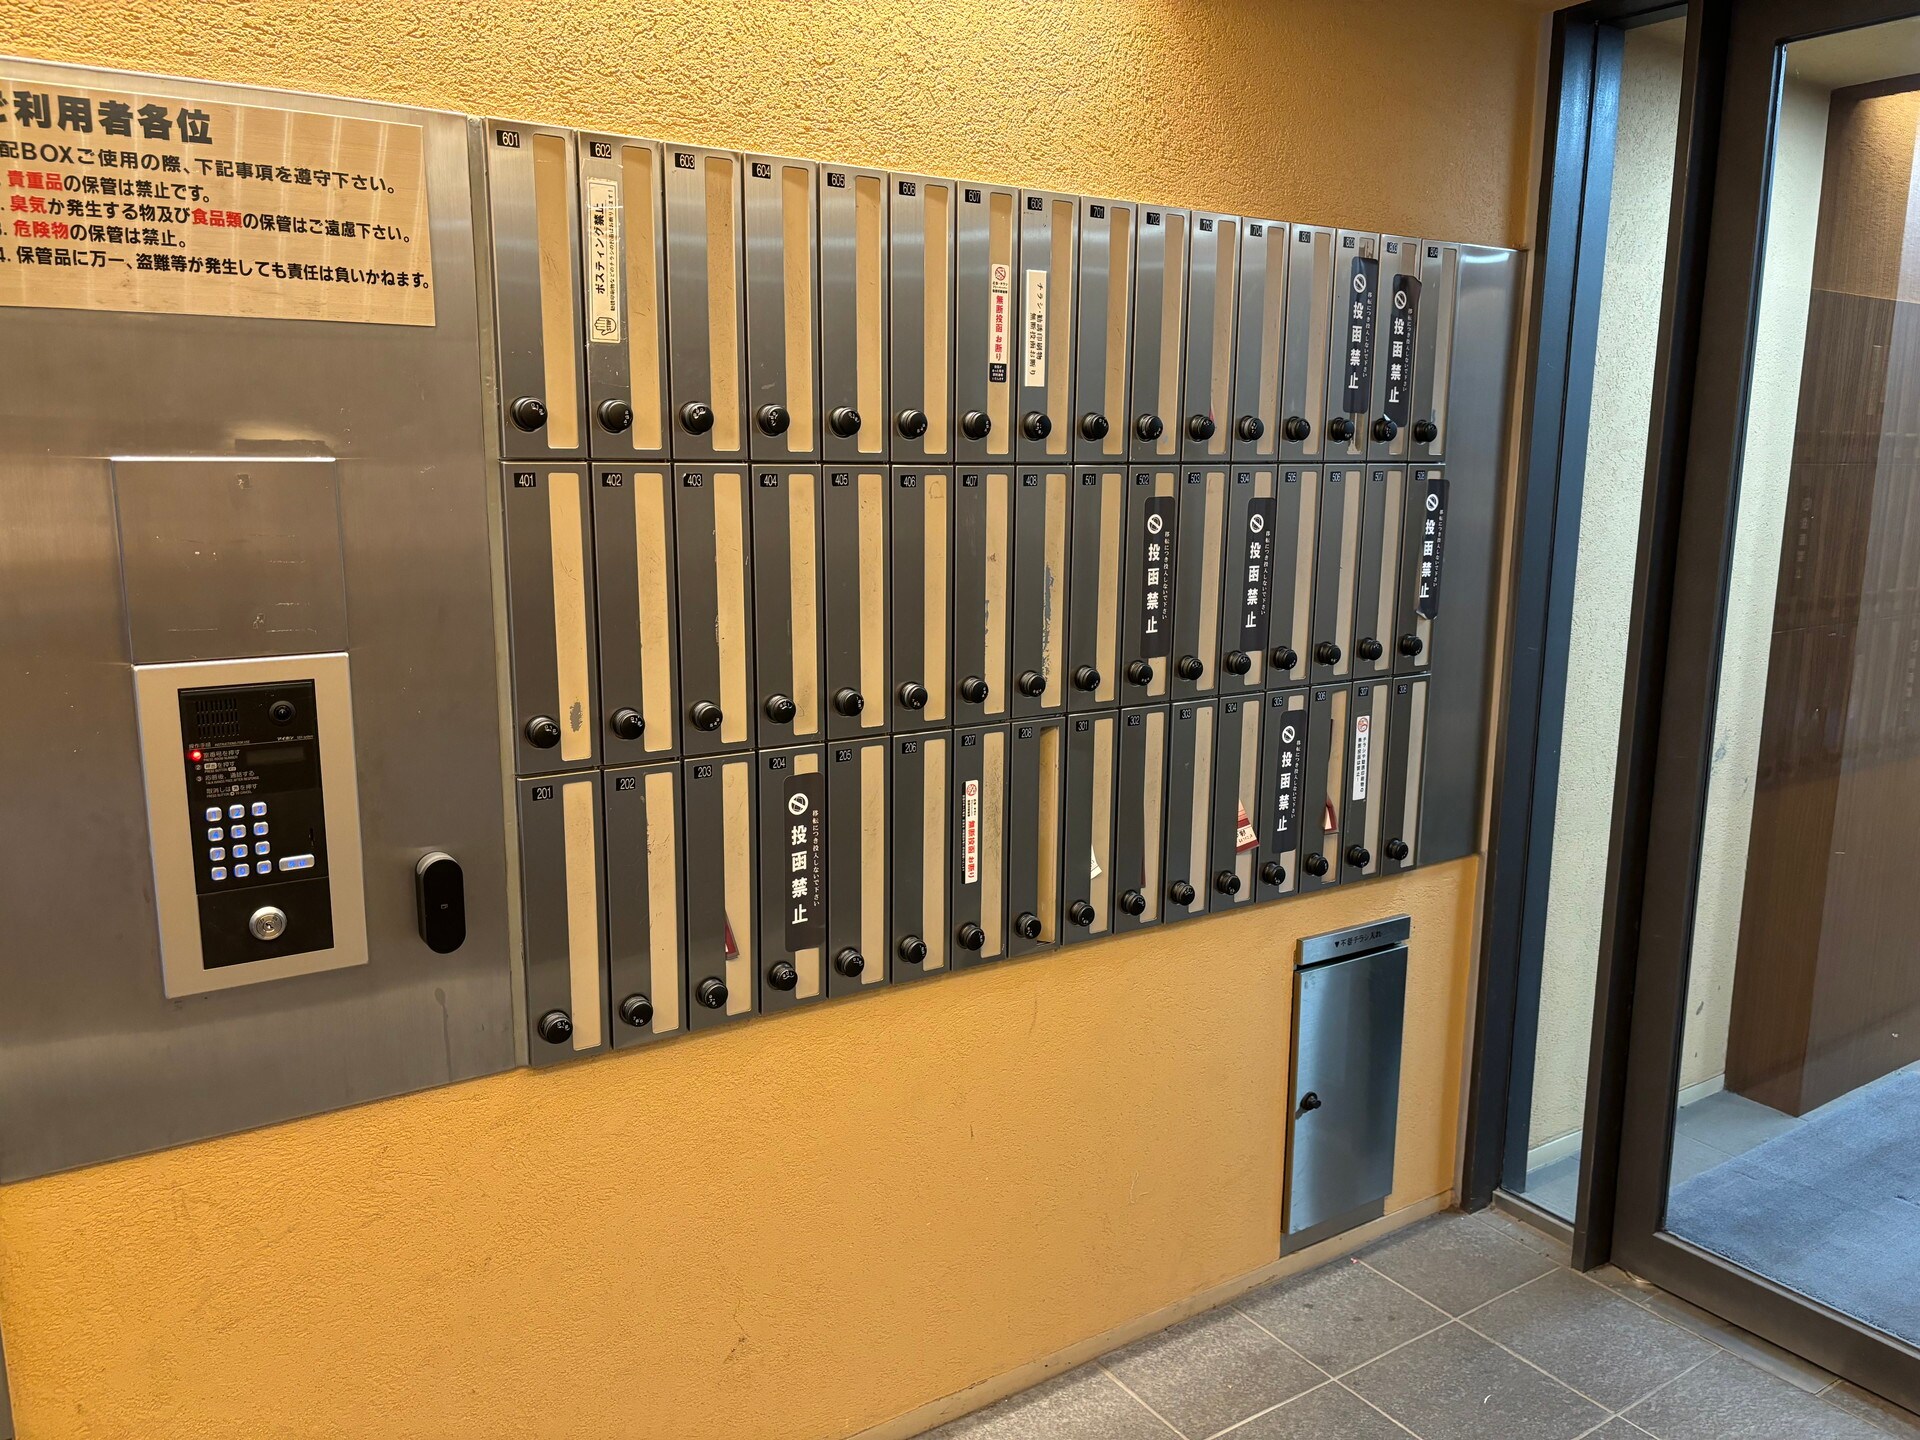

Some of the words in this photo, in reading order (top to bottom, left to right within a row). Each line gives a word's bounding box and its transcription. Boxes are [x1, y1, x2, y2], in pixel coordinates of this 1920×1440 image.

[0, 90, 213, 145] 利用者各位
[502, 131, 519, 147] 601
[595, 143, 611, 158] 602
[679, 154, 695, 169] 603
[756, 164, 771, 178] 604
[8, 170, 211, 203] 貴重品の保管は禁止です。
[831, 174, 845, 187] 605
[903, 183, 916, 196] 606
[968, 190, 981, 203] 607
[1030, 198, 1042, 210] 608
[1093, 207, 1104, 218] 701
[1149, 213, 1160, 225] 702
[1203, 220, 1213, 231] 703
[1252, 225, 1263, 236] 704
[13, 220, 187, 248] 危険物の保管は禁止。
[1300, 232, 1310, 242] 801
[594, 203, 605, 294] ポスティング禁止
[1348, 301, 1364, 389] 投函禁止
[1389, 318, 1404, 403] 投函禁止
[519, 474, 534, 487] 401
[606, 474, 622, 486] 402
[687, 475, 702, 487] 403
[764, 474, 777, 486] 404
[835, 474, 848, 485] 405
[903, 475, 916, 487] 406
[966, 475, 978, 487] 407
[1026, 475, 1037, 485] 408
[1085, 474, 1096, 485] 501
[1139, 474, 1149, 485] 502
[1191, 473, 1200, 483] 503
[1240, 473, 1250, 483] 504
[1420, 519, 1435, 598] 投函禁止
[1146, 543, 1161, 633] 投函禁止
[1245, 542, 1261, 628] 投函禁止
[1182, 709, 1192, 718] 303
[1227, 703, 1237, 712] 304
[1078, 721, 1088, 731] 301
[1130, 715, 1139, 725] 302
[1021, 728, 1032, 738] 208
[964, 736, 976, 746] 207
[905, 742, 917, 753] 206
[839, 750, 852, 761] 205
[772, 758, 786, 769] 204
[697, 767, 712, 778] 203
[620, 778, 635, 790] 202
[536, 788, 551, 800] 201
[1277, 752, 1292, 831] 投函禁止
[791, 825, 808, 925] 投函禁止
[1340, 931, 1382, 946] 不要チラシ入れ
